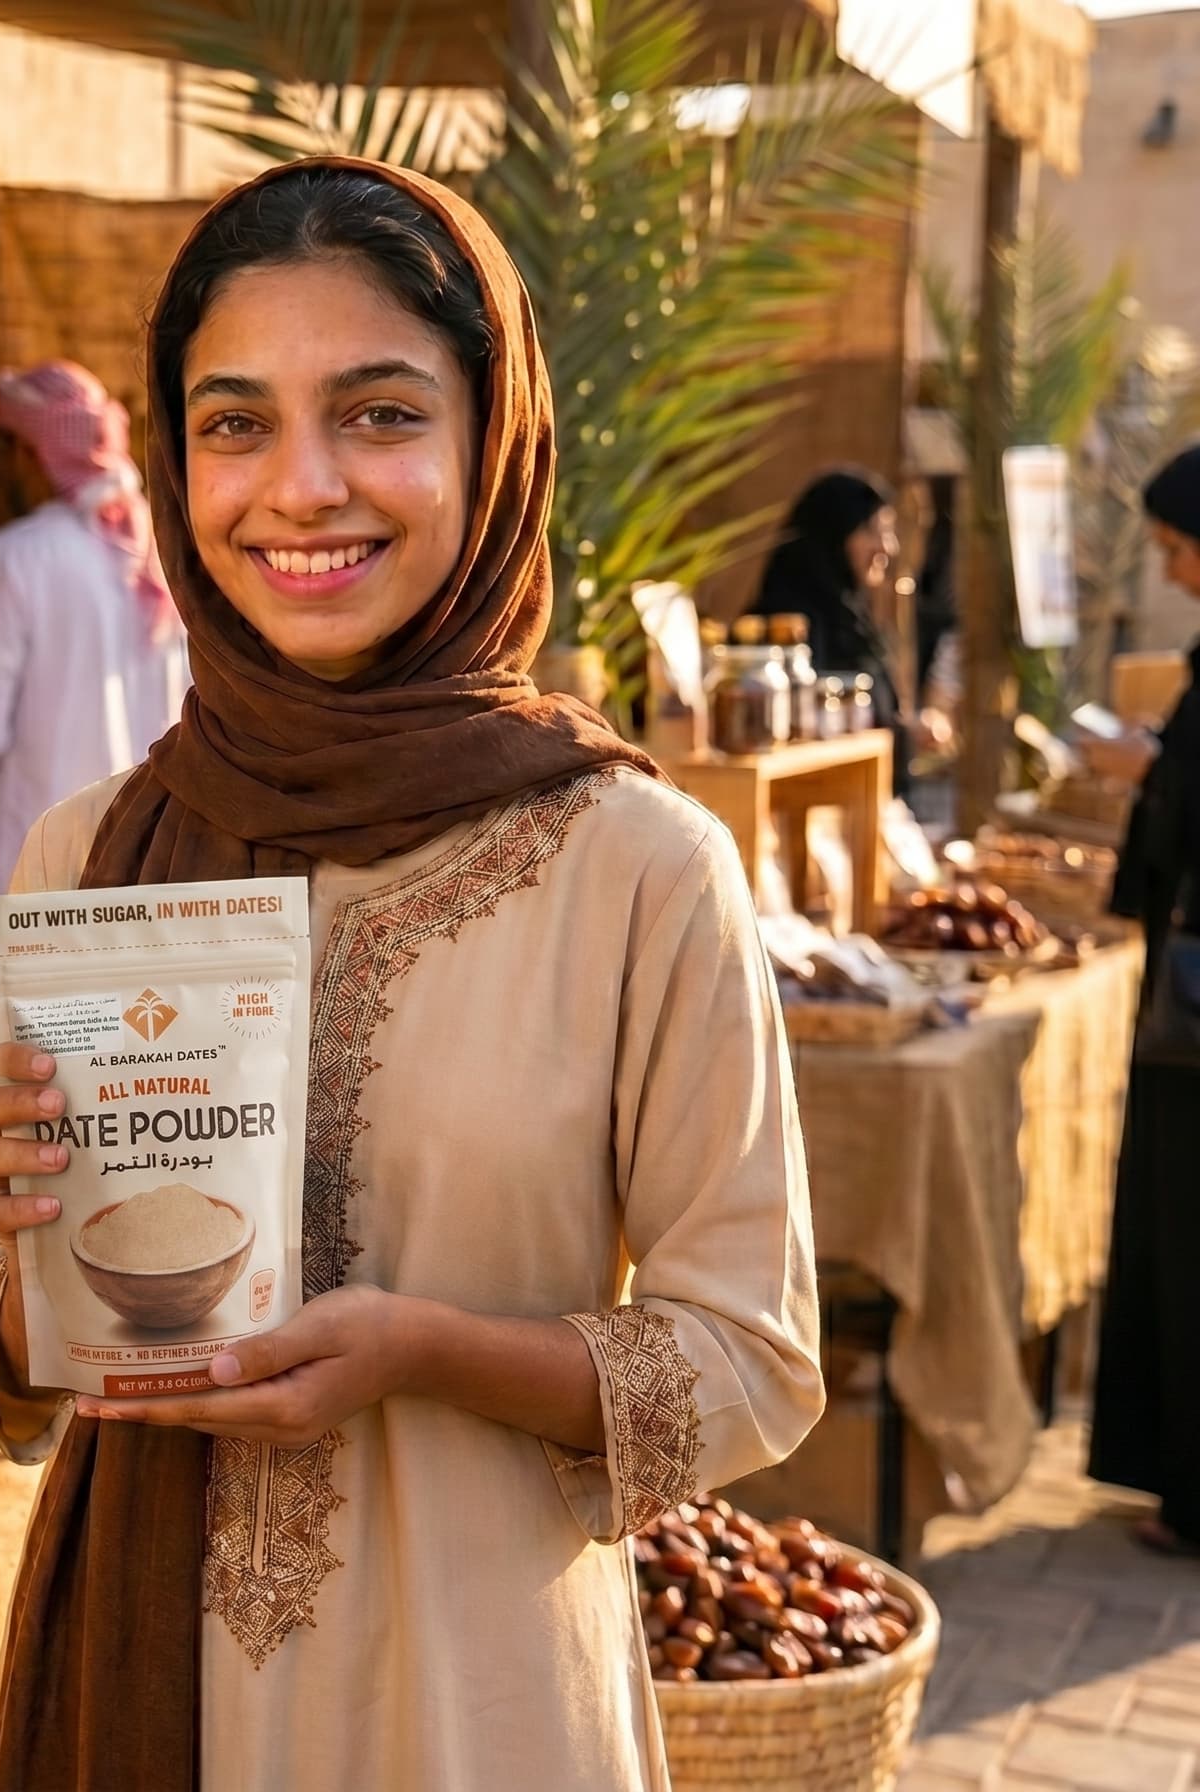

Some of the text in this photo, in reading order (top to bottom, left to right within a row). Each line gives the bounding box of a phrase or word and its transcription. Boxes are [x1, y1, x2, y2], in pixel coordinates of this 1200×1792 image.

[8, 912, 41, 930] OUT
[45, 908, 87, 927] WITH
[92, 904, 152, 924] SUGAR,
[157, 902, 174, 919] IN
[179, 899, 220, 918] WITH
[237, 992, 268, 1005] HIGH
[233, 1007, 243, 1018] IN
[90, 1057, 106, 1067] AL
[110, 1052, 173, 1066] BARAKAH
[99, 1077, 211, 1102] ALL NATURAL
[129, 1102, 276, 1146] POWDER
[100, 1153, 213, 1176] بودرة التمر
[118, 1381, 136, 1392] NET
[137, 1380, 156, 1391] WT.
